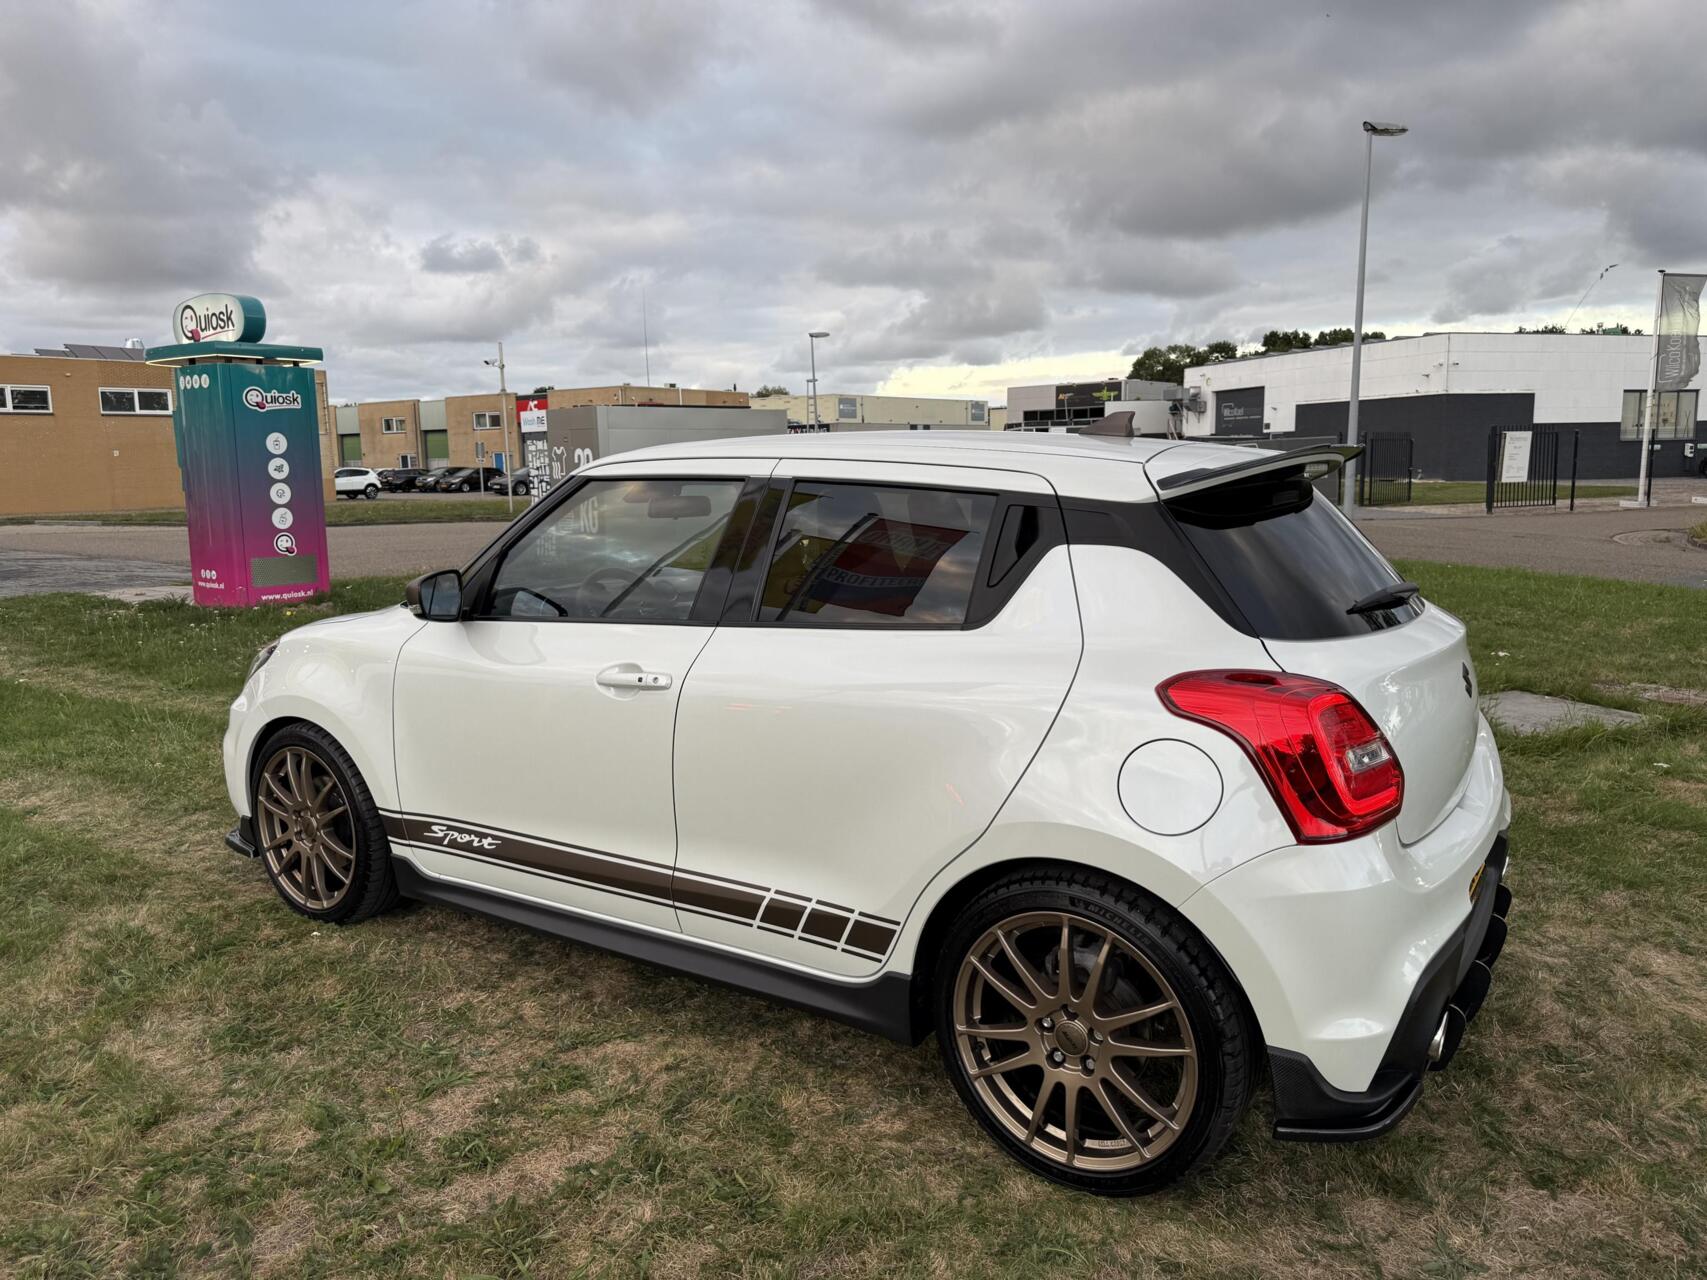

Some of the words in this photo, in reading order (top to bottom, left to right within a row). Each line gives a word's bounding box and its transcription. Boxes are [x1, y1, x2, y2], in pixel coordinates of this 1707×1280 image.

[180, 304, 235, 341] Quiosk
[244, 388, 300, 410] Quiosk
[580, 496, 599, 534] KG
[260, 588, 314, 601] www.quiosk.nl
[423, 825, 502, 849] Sport
